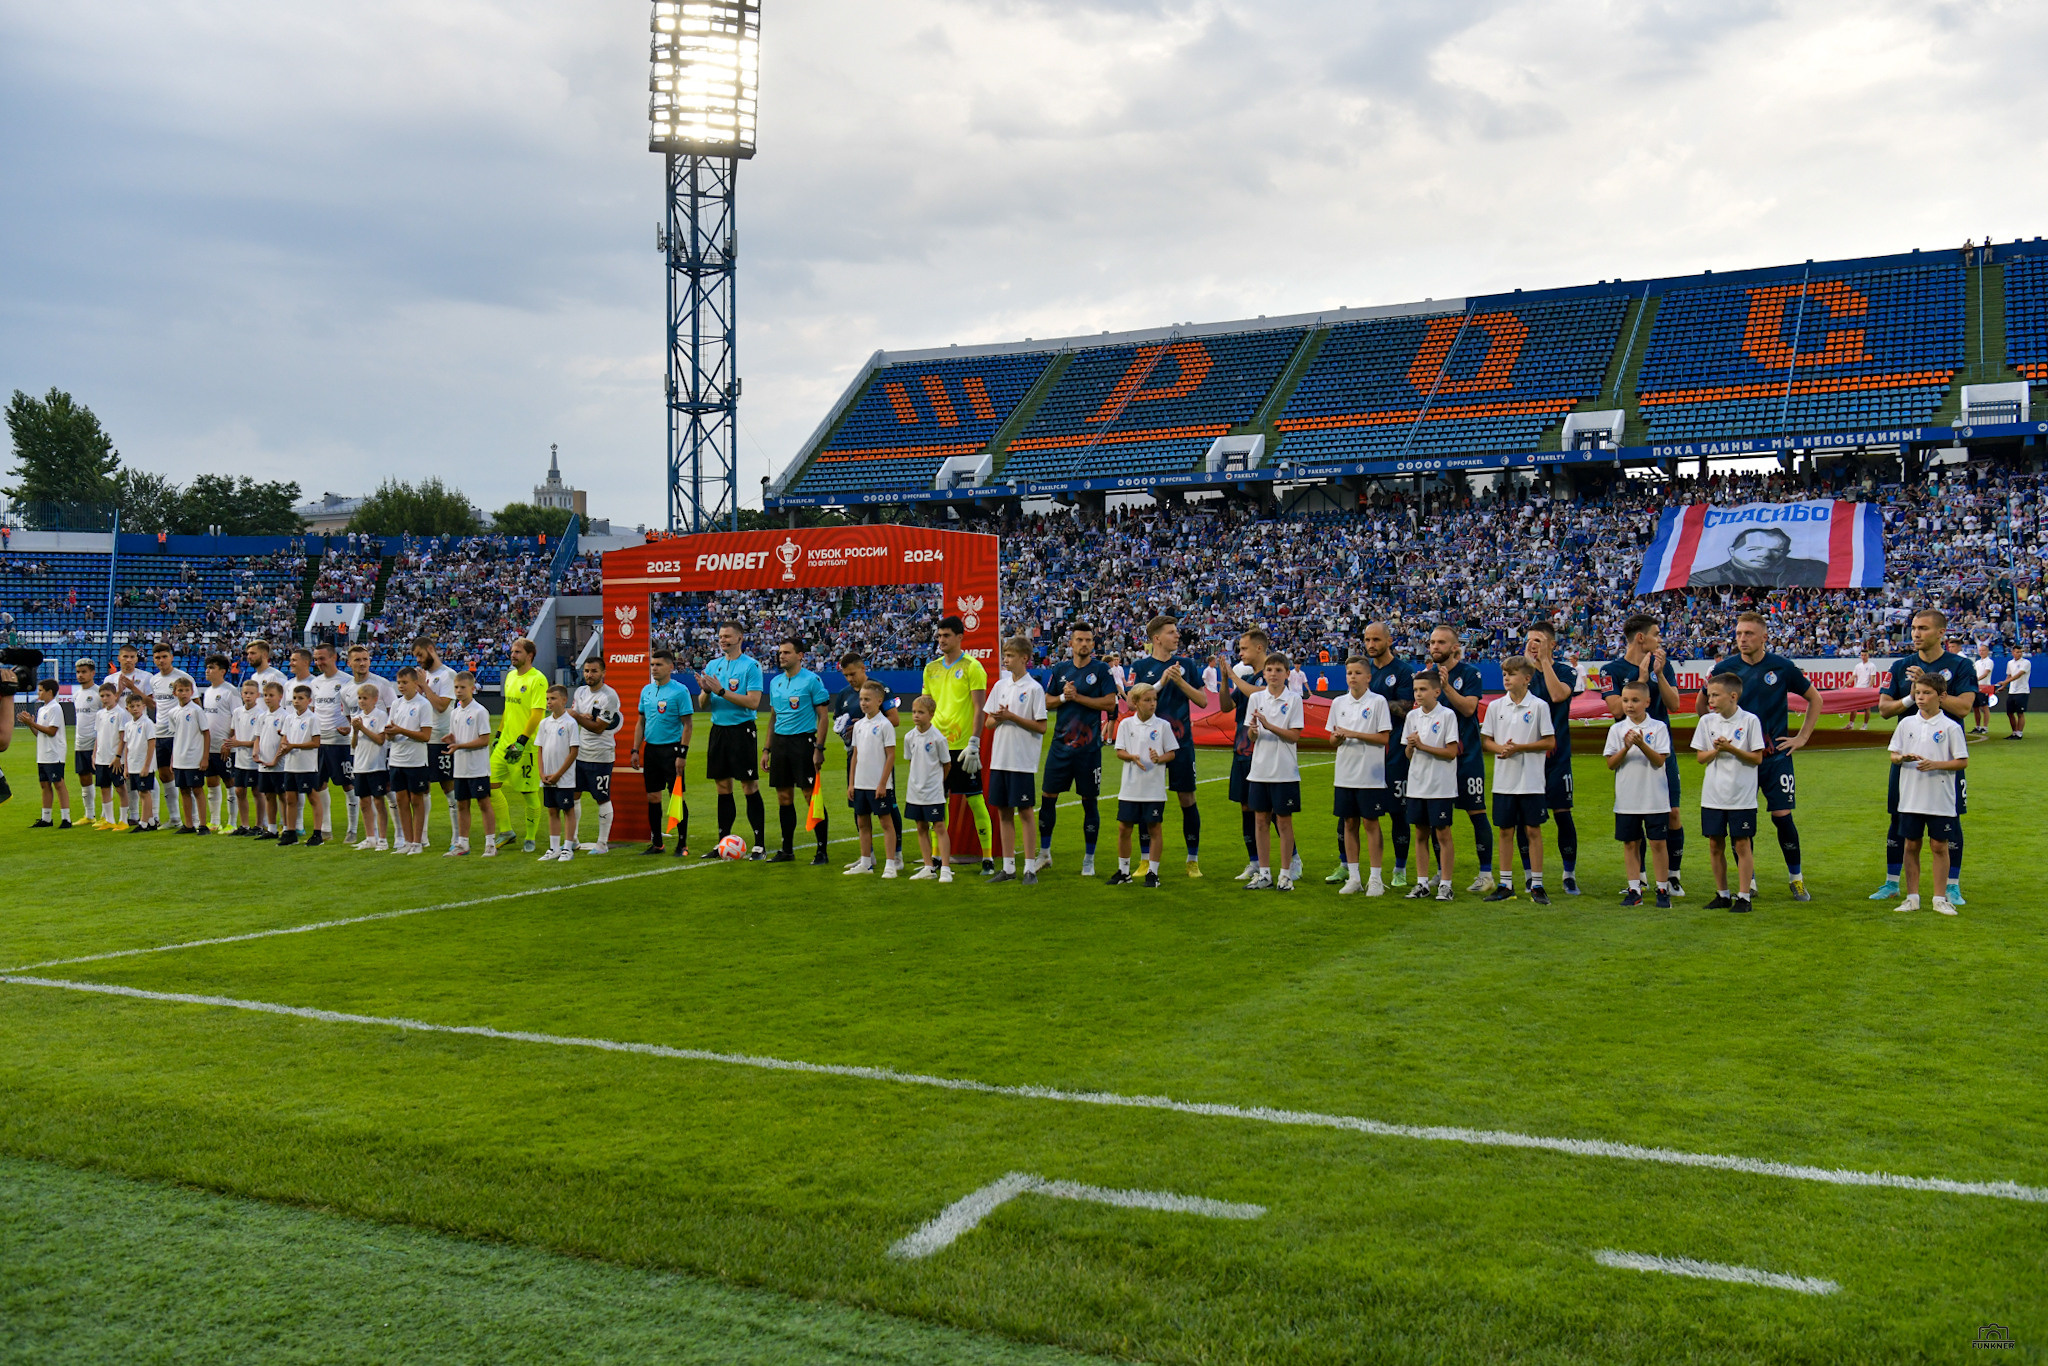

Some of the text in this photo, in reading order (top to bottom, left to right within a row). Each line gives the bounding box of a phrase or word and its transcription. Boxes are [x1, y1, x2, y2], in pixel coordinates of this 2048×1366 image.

[1653, 445, 1693, 457] ПОКА
[1701, 441, 1753, 454] ЕДИНЫ
[1771, 438, 1795, 449] МЫ
[1803, 428, 1922, 448] НЕПОБЕДИМЫ!
[1536, 454, 1566, 462] FAKELTV
[1704, 505, 1830, 529] СПАСИБО
[808, 546, 888, 560] КУБОК РОССИИ
[904, 549, 944, 563] 2024
[647, 560, 681, 573] 2023
[696, 551, 770, 572] FONBET
[818, 558, 848, 567] ФУТБОЛУ
[336, 605, 343, 614] 5
[609, 653, 645, 664] FONBET
[341, 761, 352, 774] 18
[438, 755, 451, 769] 33
[522, 765, 532, 778] 12
[596, 775, 610, 790] 27
[1394, 780, 1408, 798] 30
[1467, 777, 1483, 795] 88
[1562, 774, 1573, 792] 11
[1780, 774, 1795, 793] 92
